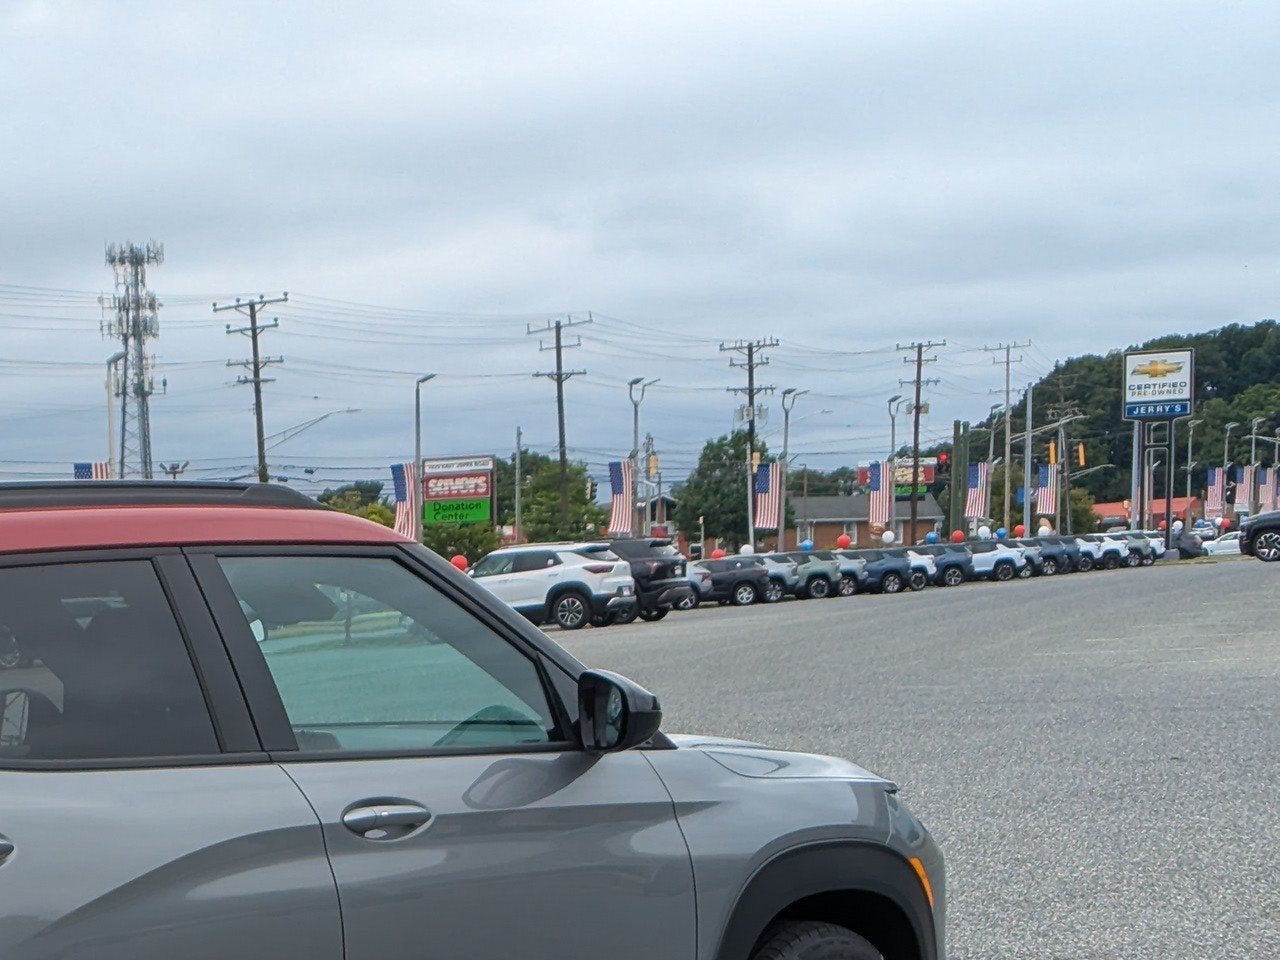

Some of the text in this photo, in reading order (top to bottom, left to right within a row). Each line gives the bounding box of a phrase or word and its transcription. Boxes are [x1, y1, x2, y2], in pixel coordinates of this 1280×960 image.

[1128, 381, 1187, 391] CERTIFIED
[1131, 388, 1184, 397] PRE-OWNED
[1133, 404, 1182, 414] JERRY'S
[433, 501, 481, 512] Donation
[433, 511, 469, 521] Center
